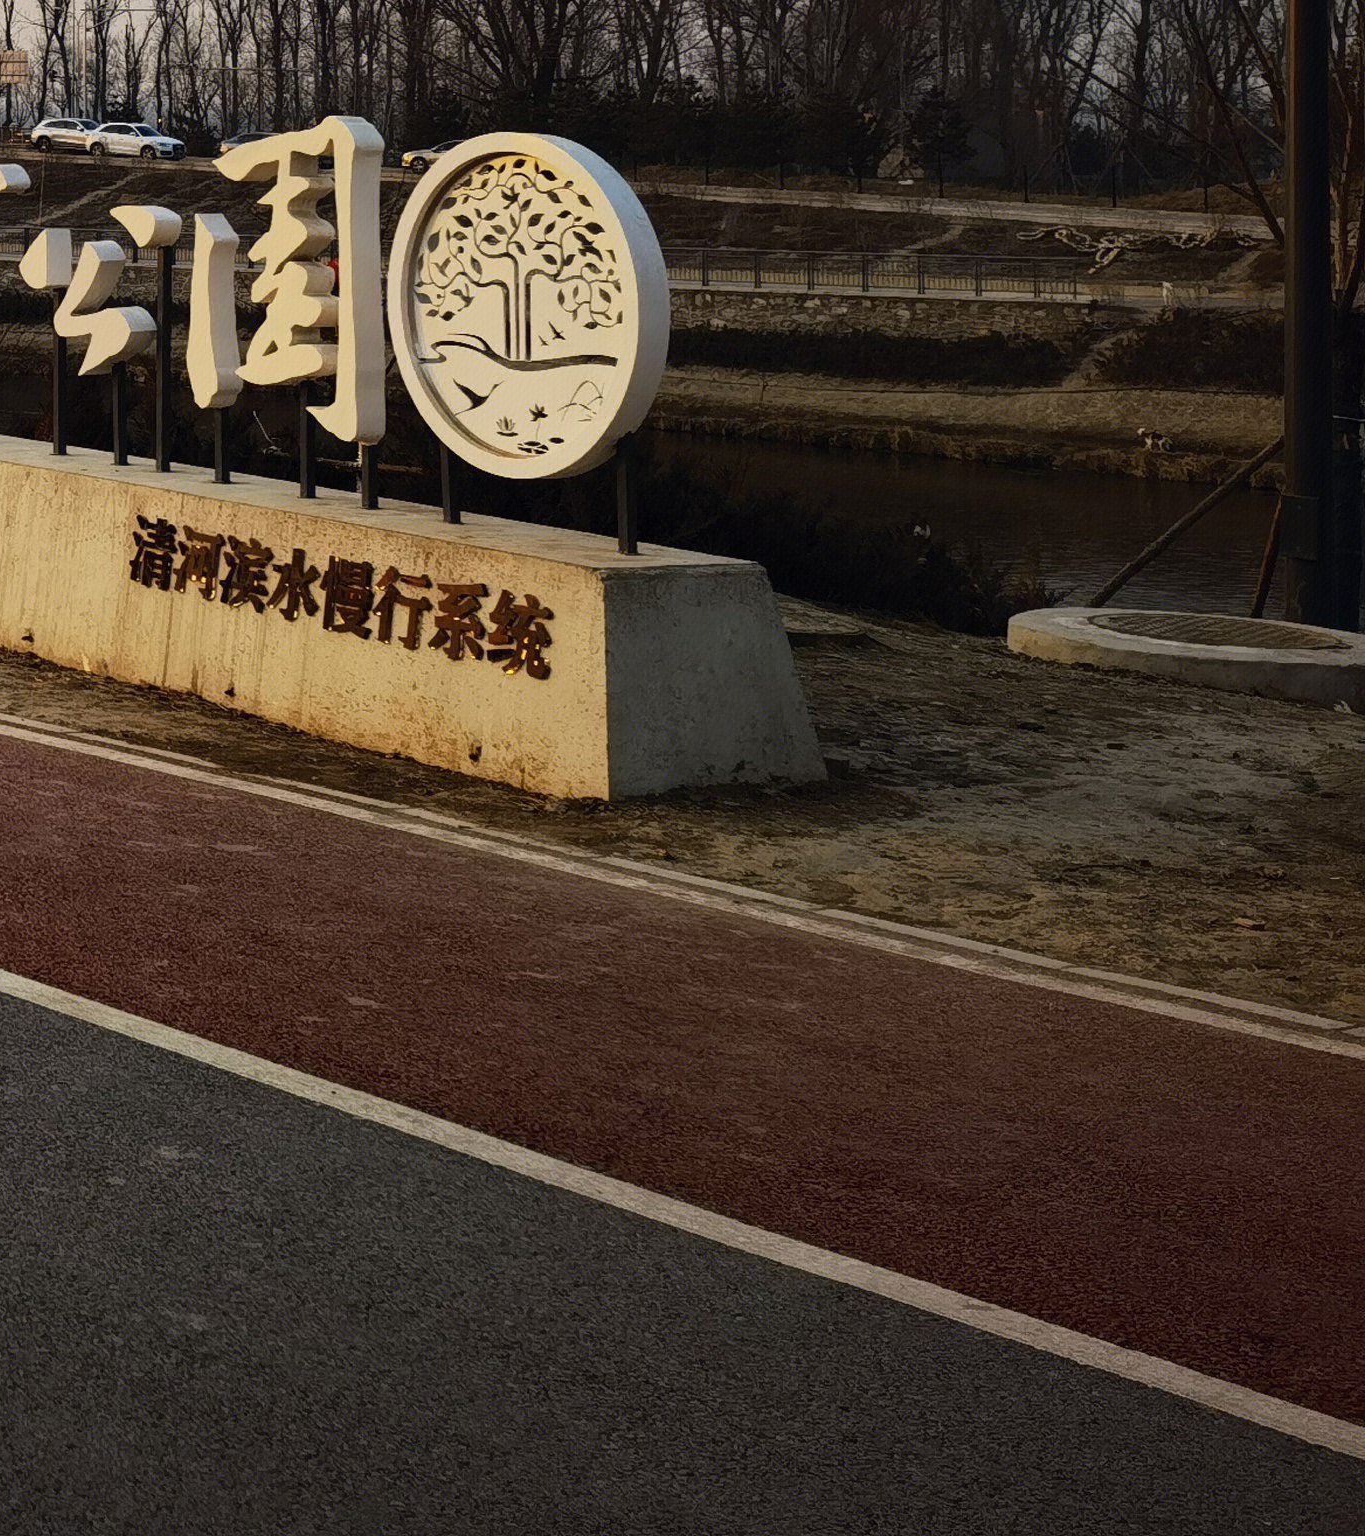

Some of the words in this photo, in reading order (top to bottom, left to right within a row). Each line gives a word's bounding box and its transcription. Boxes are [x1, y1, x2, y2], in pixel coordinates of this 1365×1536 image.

[129, 515, 554, 680] 清河滨水慢行系统
